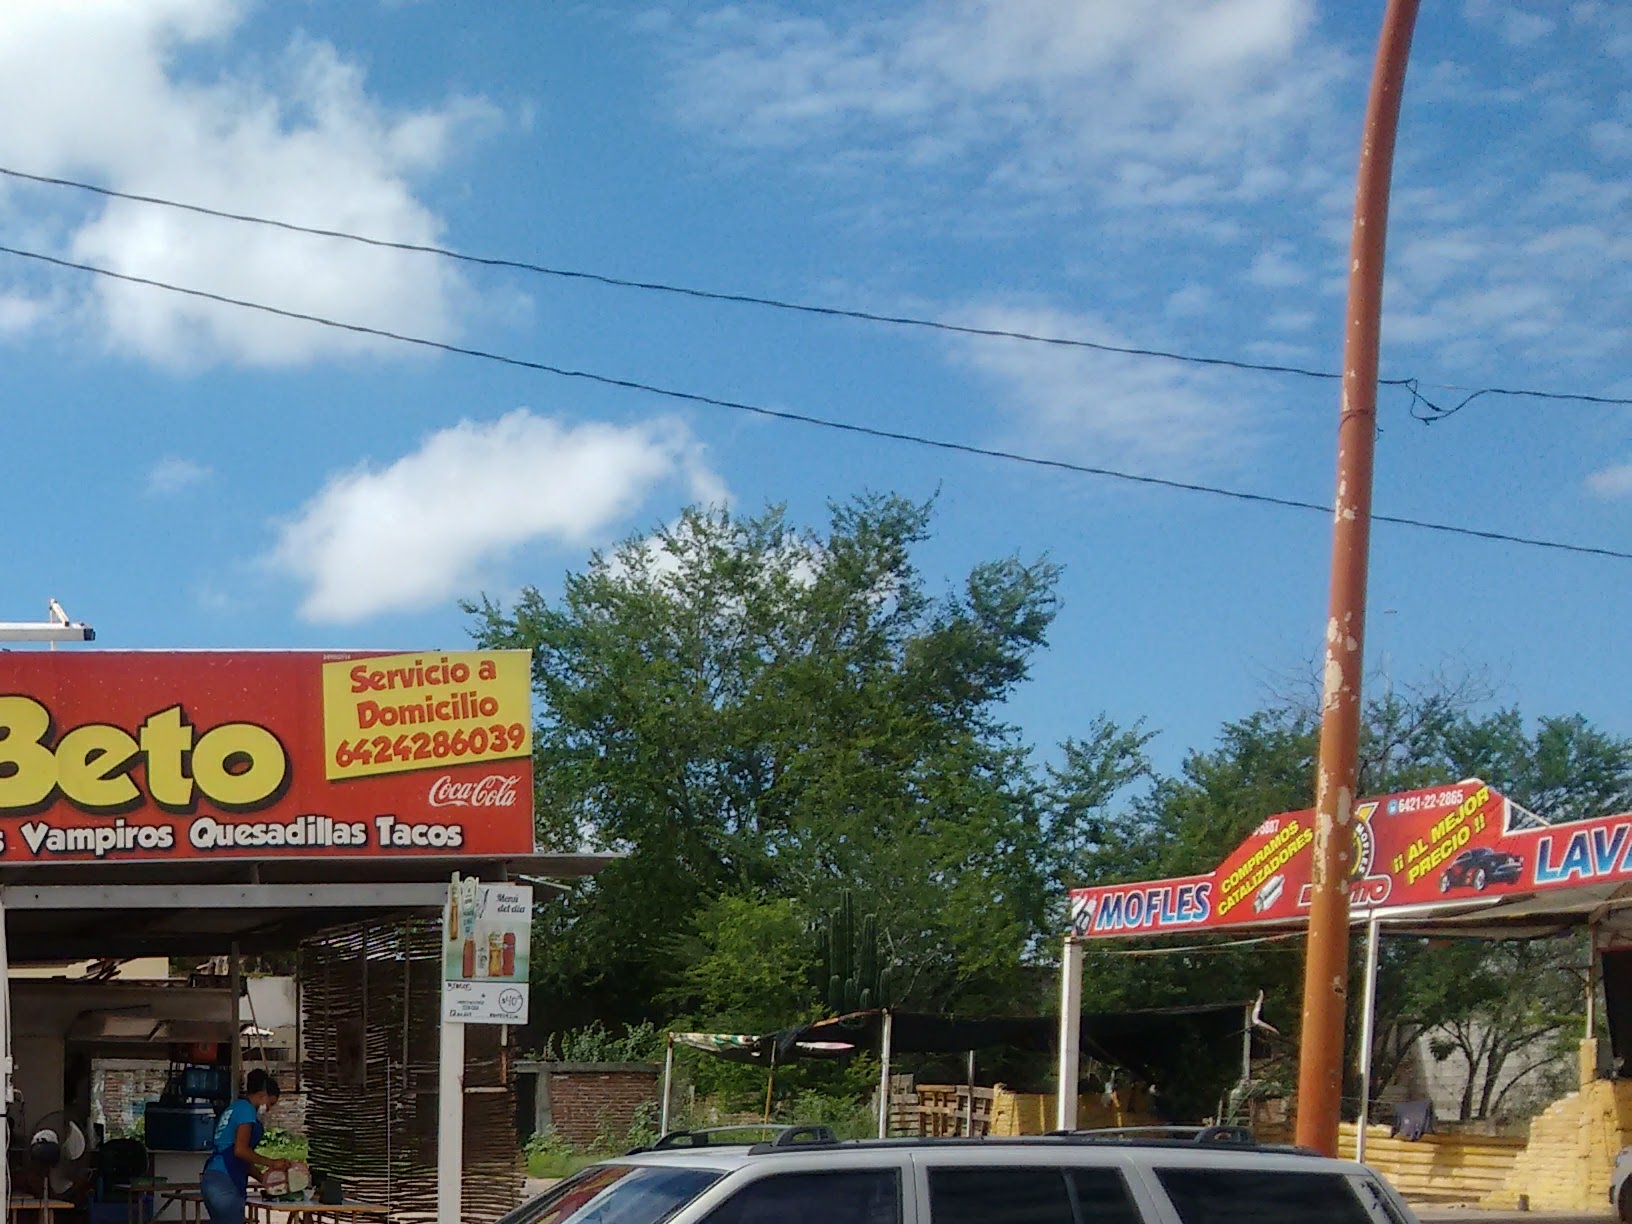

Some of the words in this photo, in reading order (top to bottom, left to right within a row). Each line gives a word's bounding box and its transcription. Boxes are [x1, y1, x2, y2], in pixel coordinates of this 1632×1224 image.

[349, 656, 470, 693] Servicio
[478, 660, 497, 681] a
[356, 690, 499, 729] Domicilio
[335, 722, 526, 768] 6424286039
[428, 775, 521, 807] Coca-Cola
[1398, 789, 1464, 813] 6421-22-2865
[20, 818, 173, 856] Vampiros
[189, 815, 367, 848] Quesadillas
[375, 815, 463, 847] Tacos
[1408, 838, 1429, 863] AL
[1430, 785, 1489, 844] MEJOR
[1218, 828, 1313, 915] CATALIZADORES
[1221, 820, 1299, 893] COMPRAMOS
[1408, 825, 1471, 885] PRECIO
[1094, 882, 1213, 931] MOFLES
